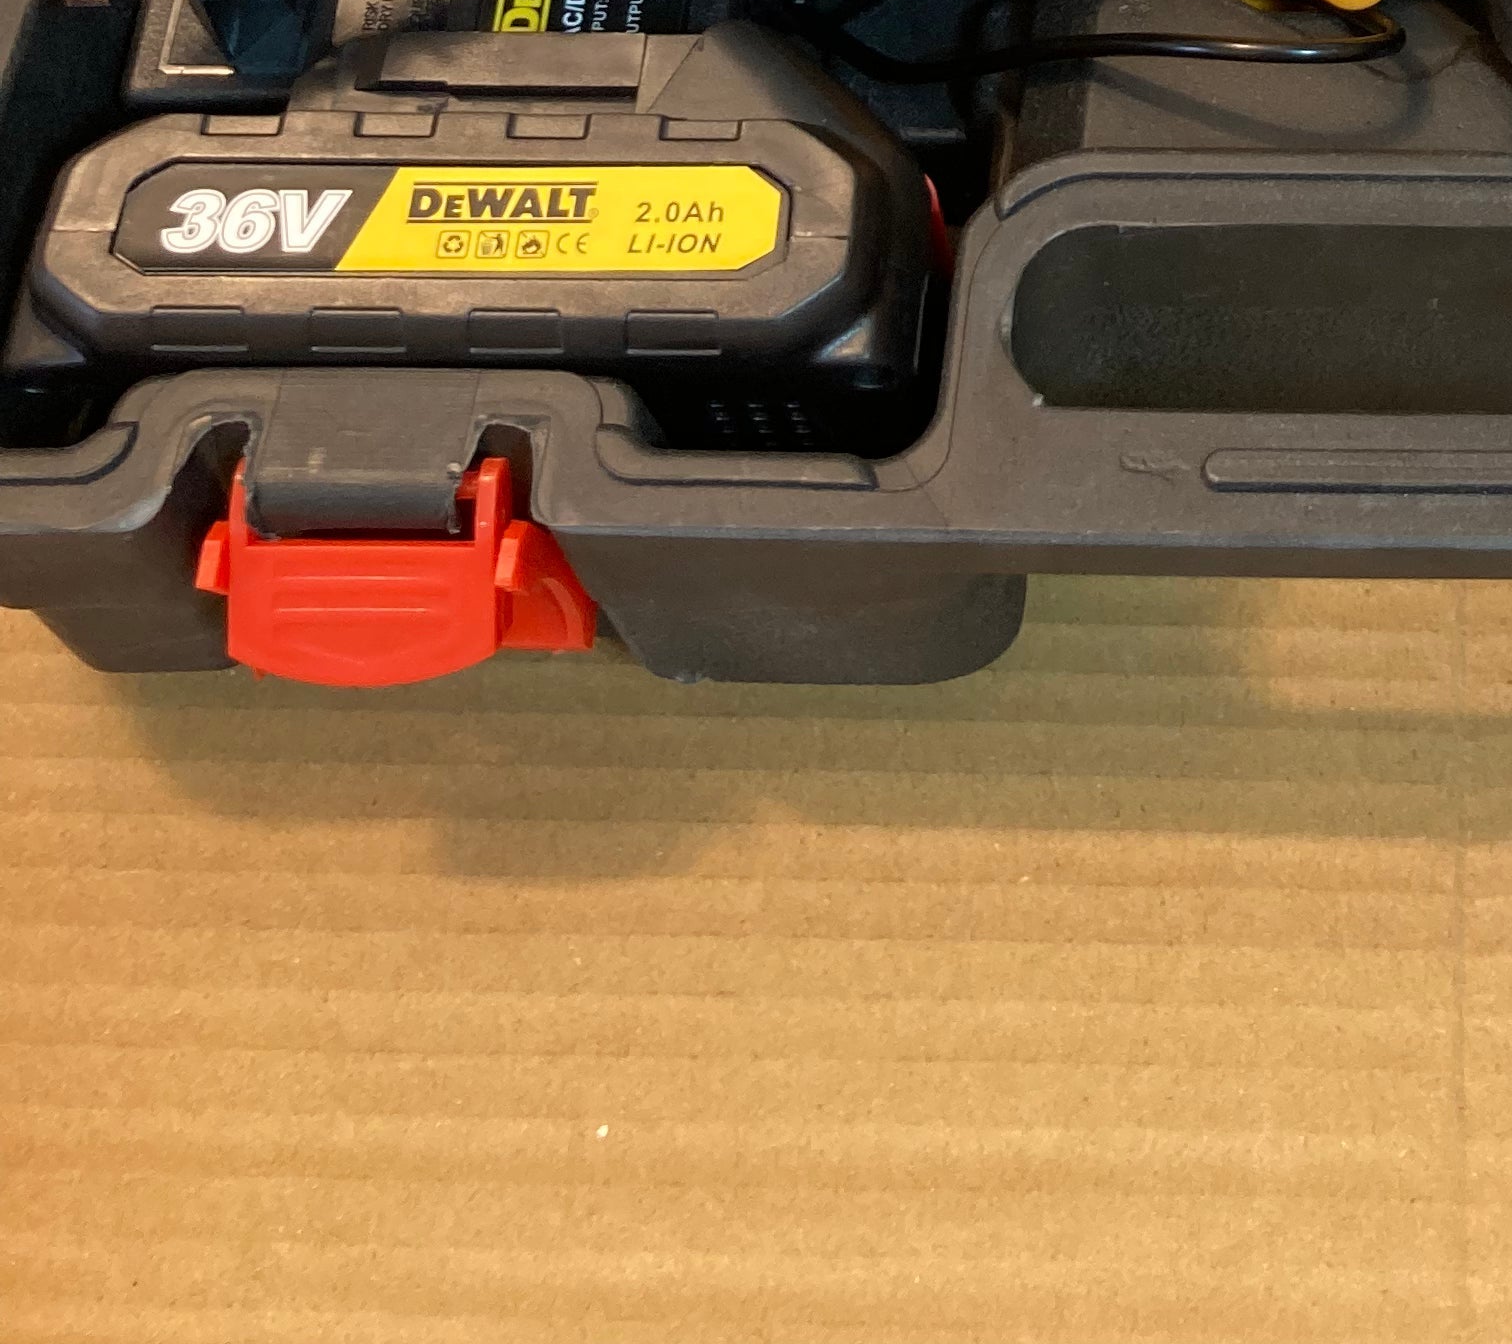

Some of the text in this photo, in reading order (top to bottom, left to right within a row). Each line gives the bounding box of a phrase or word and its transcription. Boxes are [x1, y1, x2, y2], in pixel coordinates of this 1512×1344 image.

[362, 1, 380, 30] RISK
[377, 4, 393, 30] DRY
[160, 188, 353, 253] 36V
[635, 201, 725, 223] 2.0Ah
[627, 232, 722, 254] LI-ION
